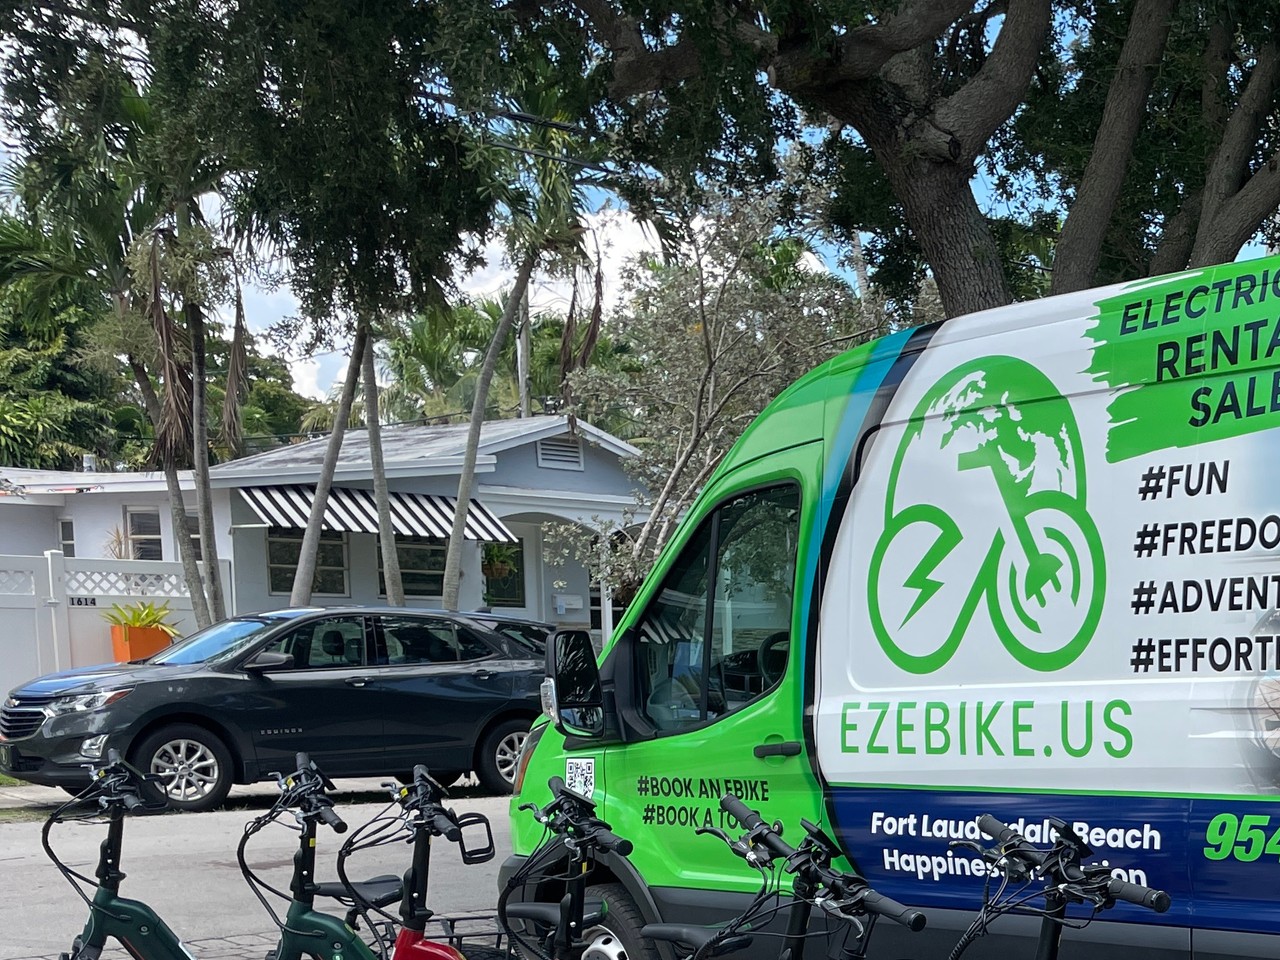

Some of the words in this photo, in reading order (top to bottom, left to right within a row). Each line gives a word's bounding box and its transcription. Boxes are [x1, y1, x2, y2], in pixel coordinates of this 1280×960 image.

[1138, 460, 1230, 500] #FUN
[71, 598, 96, 606] 1614
[840, 699, 1133, 759] EZEBIKE.US
[637, 775, 694, 797] #BOOK
[699, 779, 720, 798] AN
[725, 780, 769, 802] EBIKE
[643, 804, 699, 827] #BOOK
[703, 807, 714, 828] A
[718, 808, 761, 830] TO
[870, 811, 917, 837] Fort
[922, 814, 1060, 845] Lauddale
[1072, 820, 1161, 849] Beach
